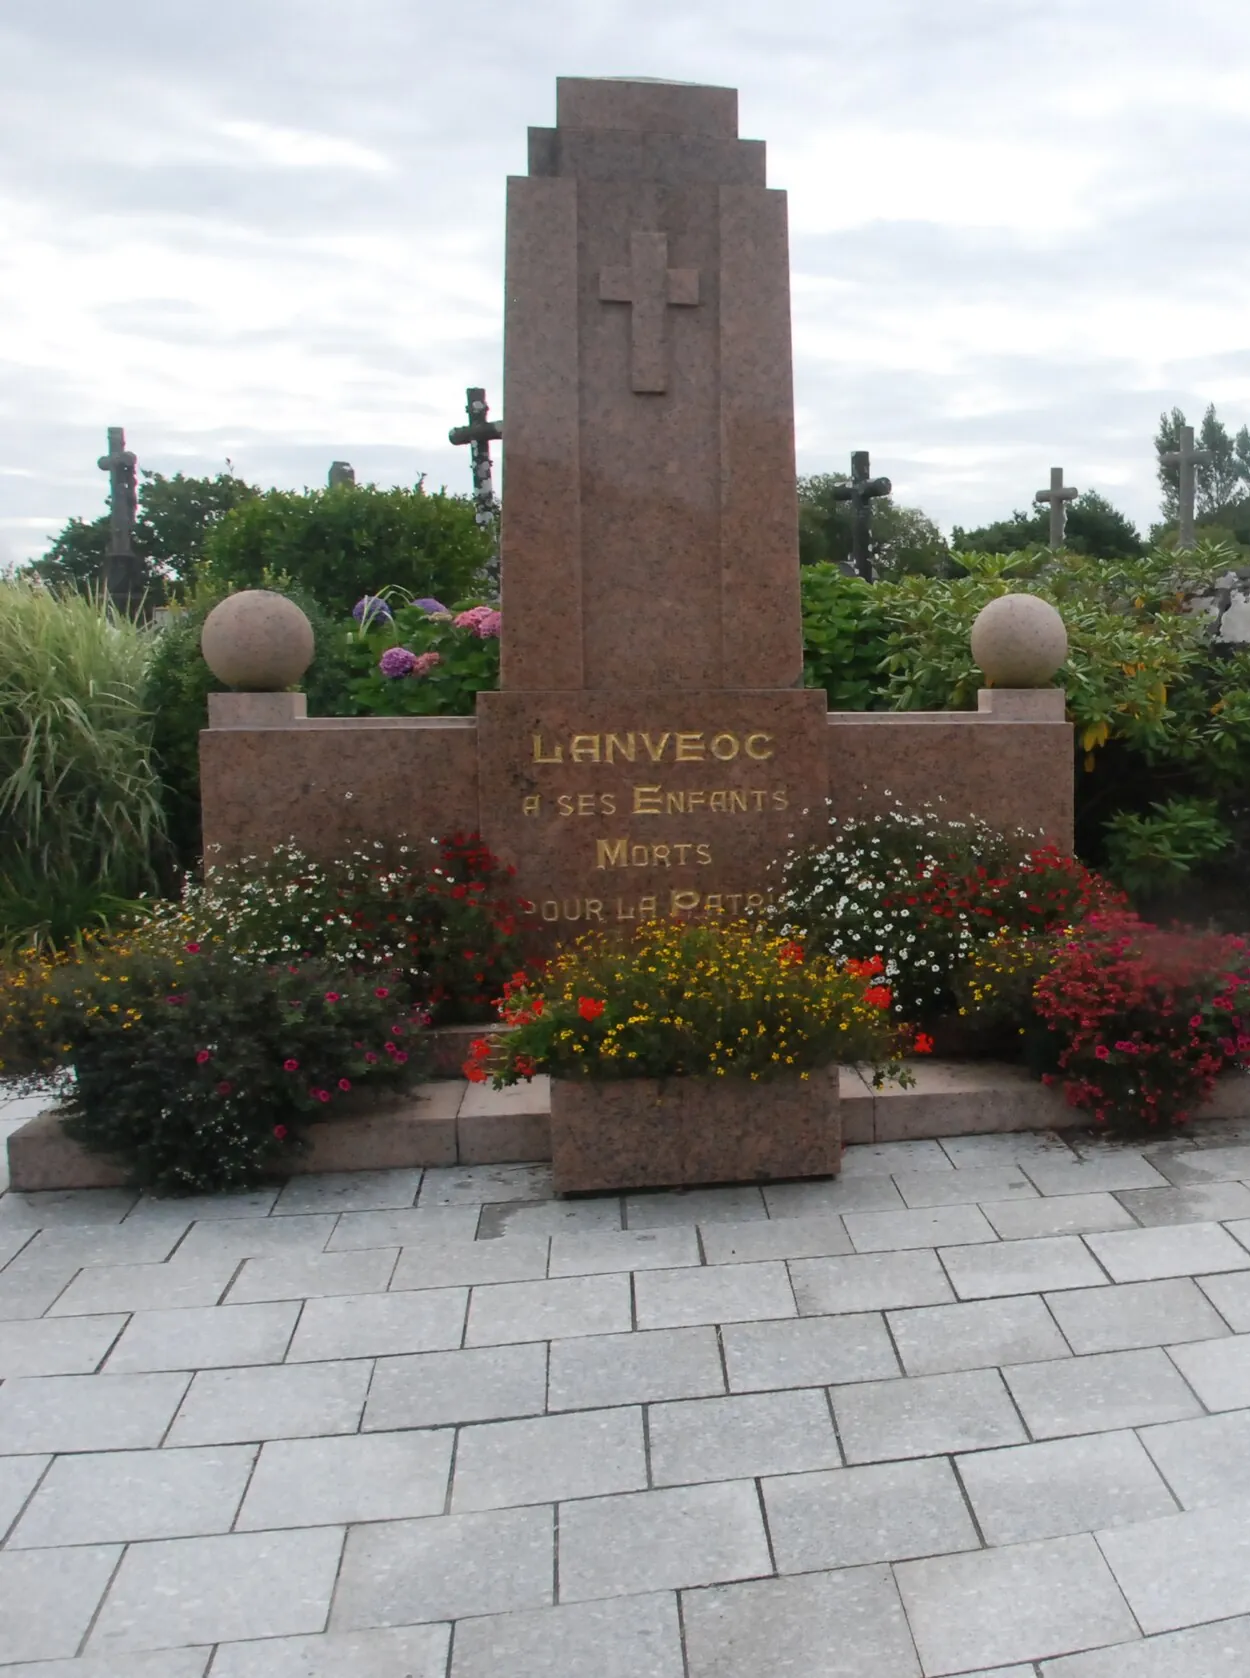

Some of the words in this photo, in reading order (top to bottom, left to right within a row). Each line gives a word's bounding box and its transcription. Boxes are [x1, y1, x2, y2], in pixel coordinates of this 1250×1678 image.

[533, 732, 774, 763] LANVEOC
[557, 794, 617, 816] SES
[632, 785, 789, 815] ENFANTS
[596, 838, 712, 870] MORTS
[617, 896, 657, 920] LA
